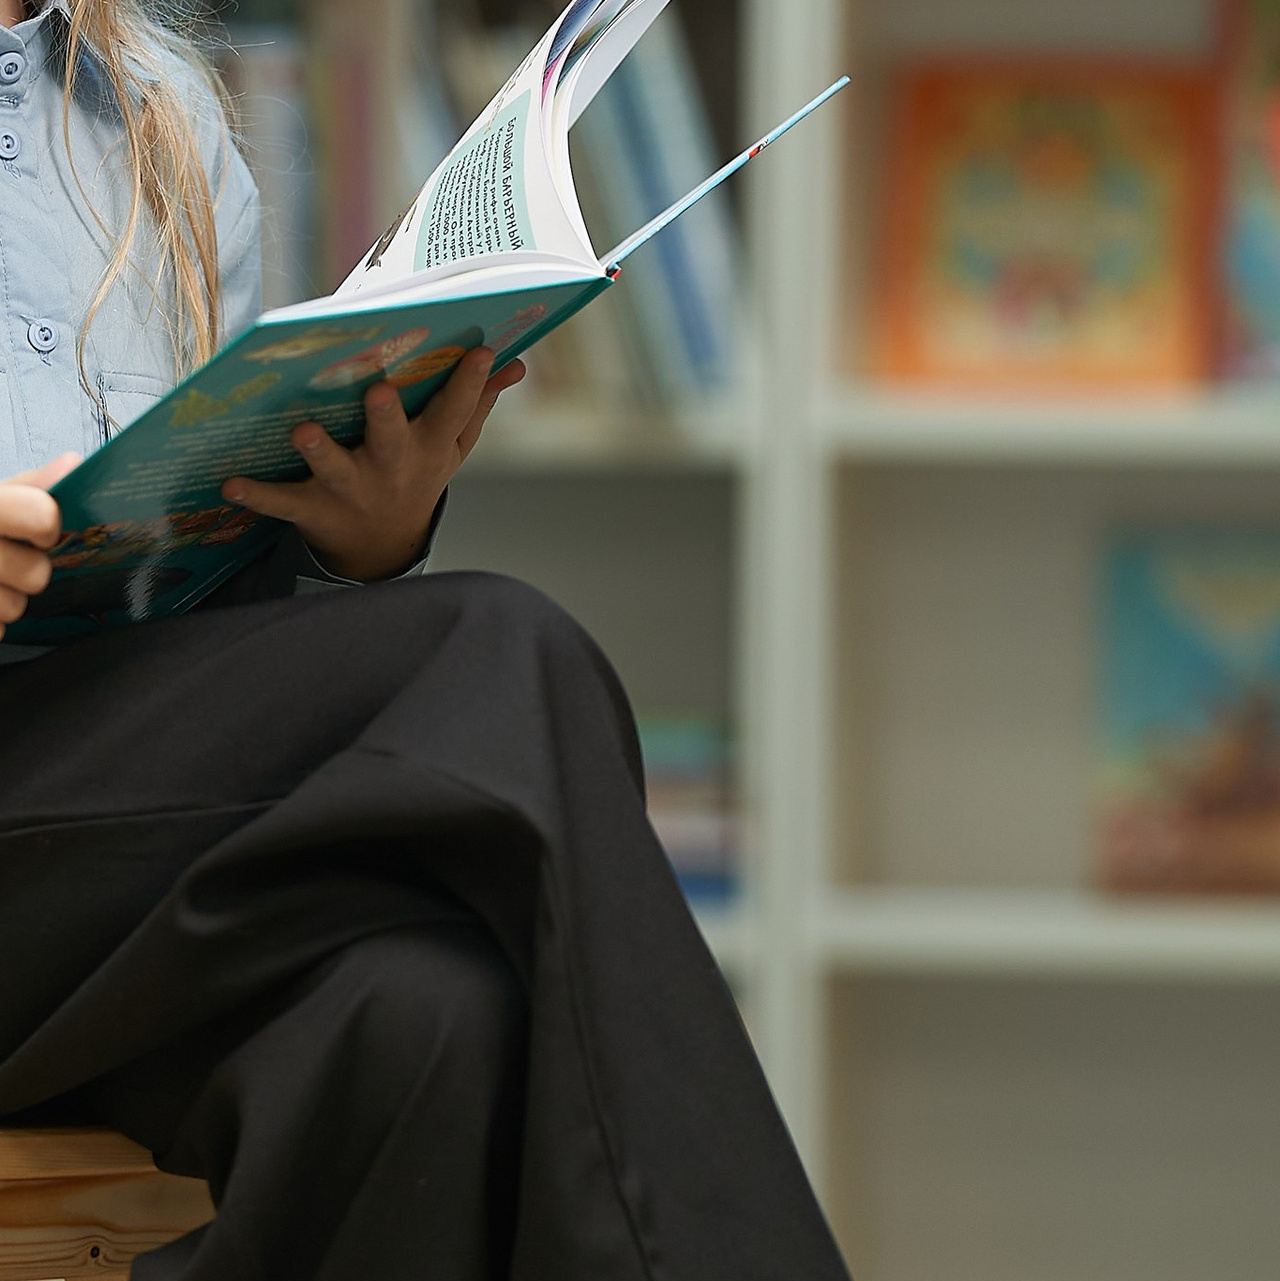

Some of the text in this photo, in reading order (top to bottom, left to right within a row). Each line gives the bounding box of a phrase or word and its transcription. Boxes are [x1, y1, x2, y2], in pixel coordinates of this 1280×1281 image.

[449, 193, 459, 219] мире.
[458, 169, 470, 228] крупнейшим
[466, 165, 477, 217] побережья
[474, 162, 483, 239] расположенный
[483, 180, 491, 224] Большой
[490, 126, 504, 247] Коралловые рифы очень
[502, 117, 524, 251] БОЛЬШОЙ БАРЬЕРНЫЙ
[427, 221, 436, 246] 1500
[442, 210, 451, 235] 2000
[442, 238, 448, 251] км
[450, 221, 458, 237] Он
